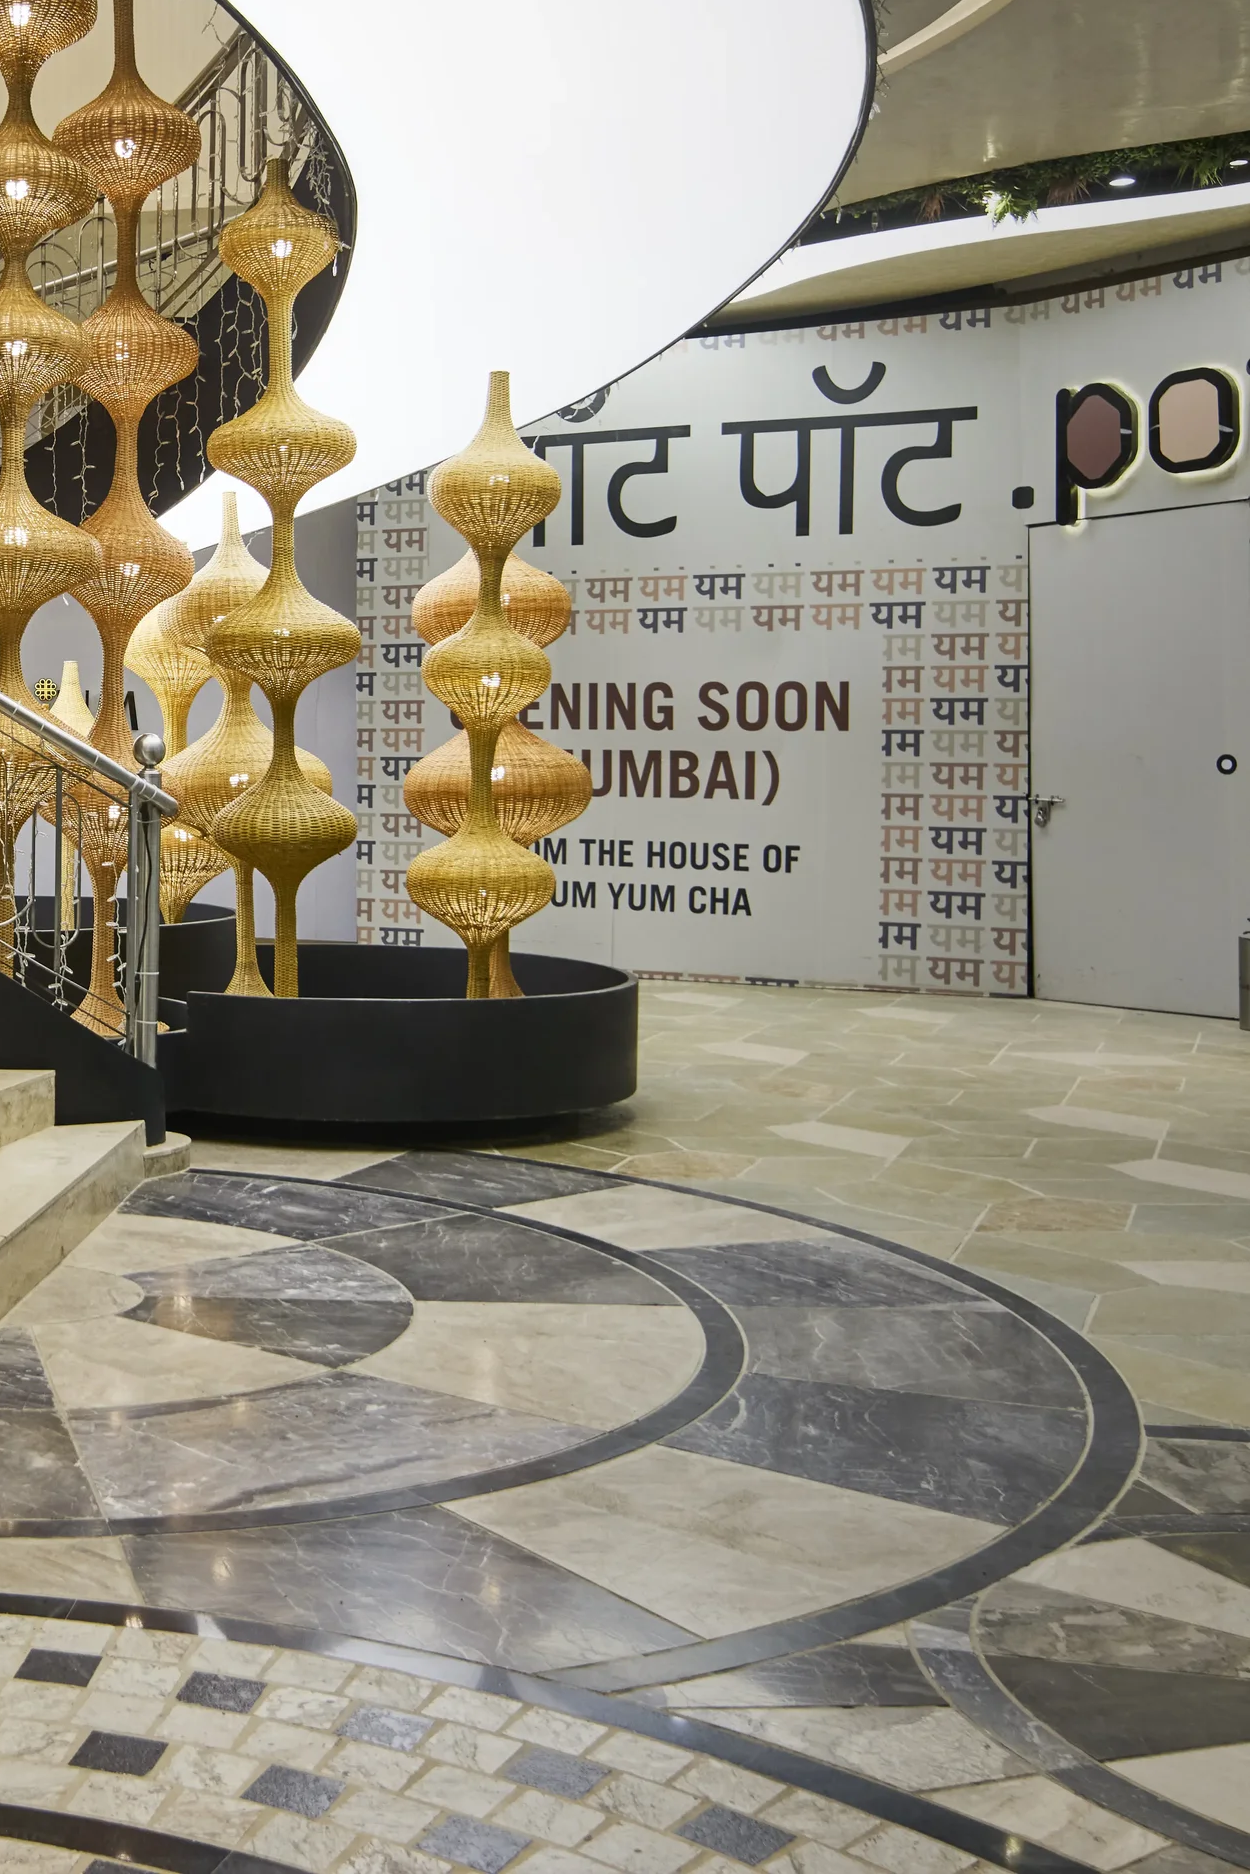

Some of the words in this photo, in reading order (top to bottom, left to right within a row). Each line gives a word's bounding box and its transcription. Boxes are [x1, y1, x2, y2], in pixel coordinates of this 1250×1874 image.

[939, 308, 991, 330] यम
[1061, 287, 1105, 314] यम
[1173, 261, 1222, 289] यम
[721, 362, 978, 537] पॉट
[382, 499, 427, 524] यम
[382, 528, 427, 553] यम
[382, 556, 427, 581] यम
[585, 577, 633, 603] यम
[638, 575, 688, 601] यम
[693, 573, 745, 600] यम
[751, 572, 805, 598] यम
[810, 570, 865, 597] यम
[870, 568, 927, 595] यम
[932, 566, 991, 594] यम
[584, 609, 632, 634] यम
[637, 607, 688, 633] यम
[693, 606, 745, 632] यम
[750, 605, 804, 632] यम
[810, 603, 864, 630] यम
[869, 601, 926, 629] यम
[931, 600, 990, 627] यम
[381, 643, 426, 668] यम
[931, 633, 989, 660] यम
[381, 672, 422, 696] यम
[930, 665, 989, 693] यम
[381, 700, 425, 724] यम
[451, 682, 674, 731] ENING
[698, 681, 850, 732] SOON
[930, 698, 988, 725] यम
[380, 728, 425, 752] यम
[930, 730, 988, 757] यम
[929, 762, 988, 790] यम
[929, 794, 987, 822] यम
[929, 826, 987, 855] यम
[579, 838, 634, 867] THE
[647, 840, 750, 872] HOUSE
[762, 844, 801, 873] OF
[928, 859, 986, 887] यम
[551, 880, 596, 909] UM
[608, 882, 676, 913] YUM
[688, 884, 752, 916] CHA
[928, 890, 986, 920] यम
[927, 924, 985, 953] यम
[926, 957, 984, 987] यम
